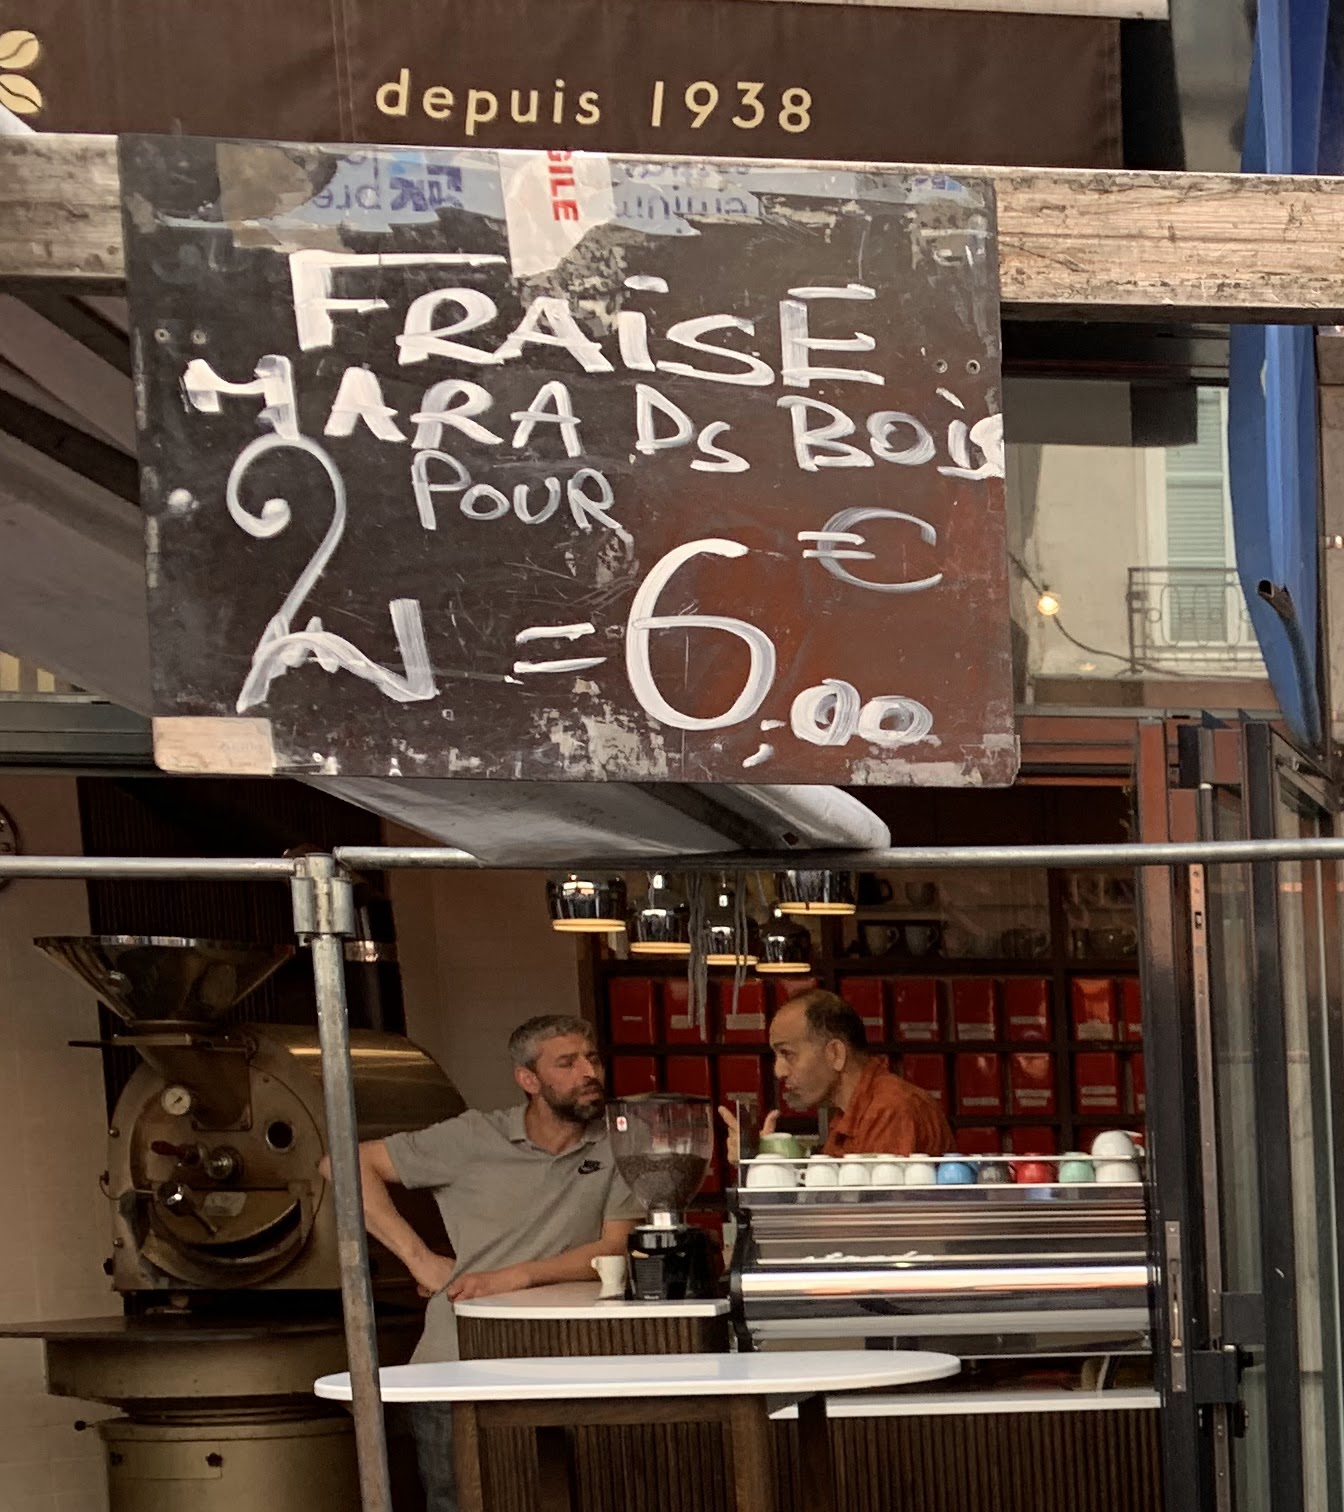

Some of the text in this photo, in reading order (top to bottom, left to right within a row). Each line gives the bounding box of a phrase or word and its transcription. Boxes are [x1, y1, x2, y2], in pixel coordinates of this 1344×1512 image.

[375, 67, 813, 136] depuis 1938
[184, 353, 583, 456] MARA
[411, 449, 622, 531] POUR
[797, 506, 944, 594] €
